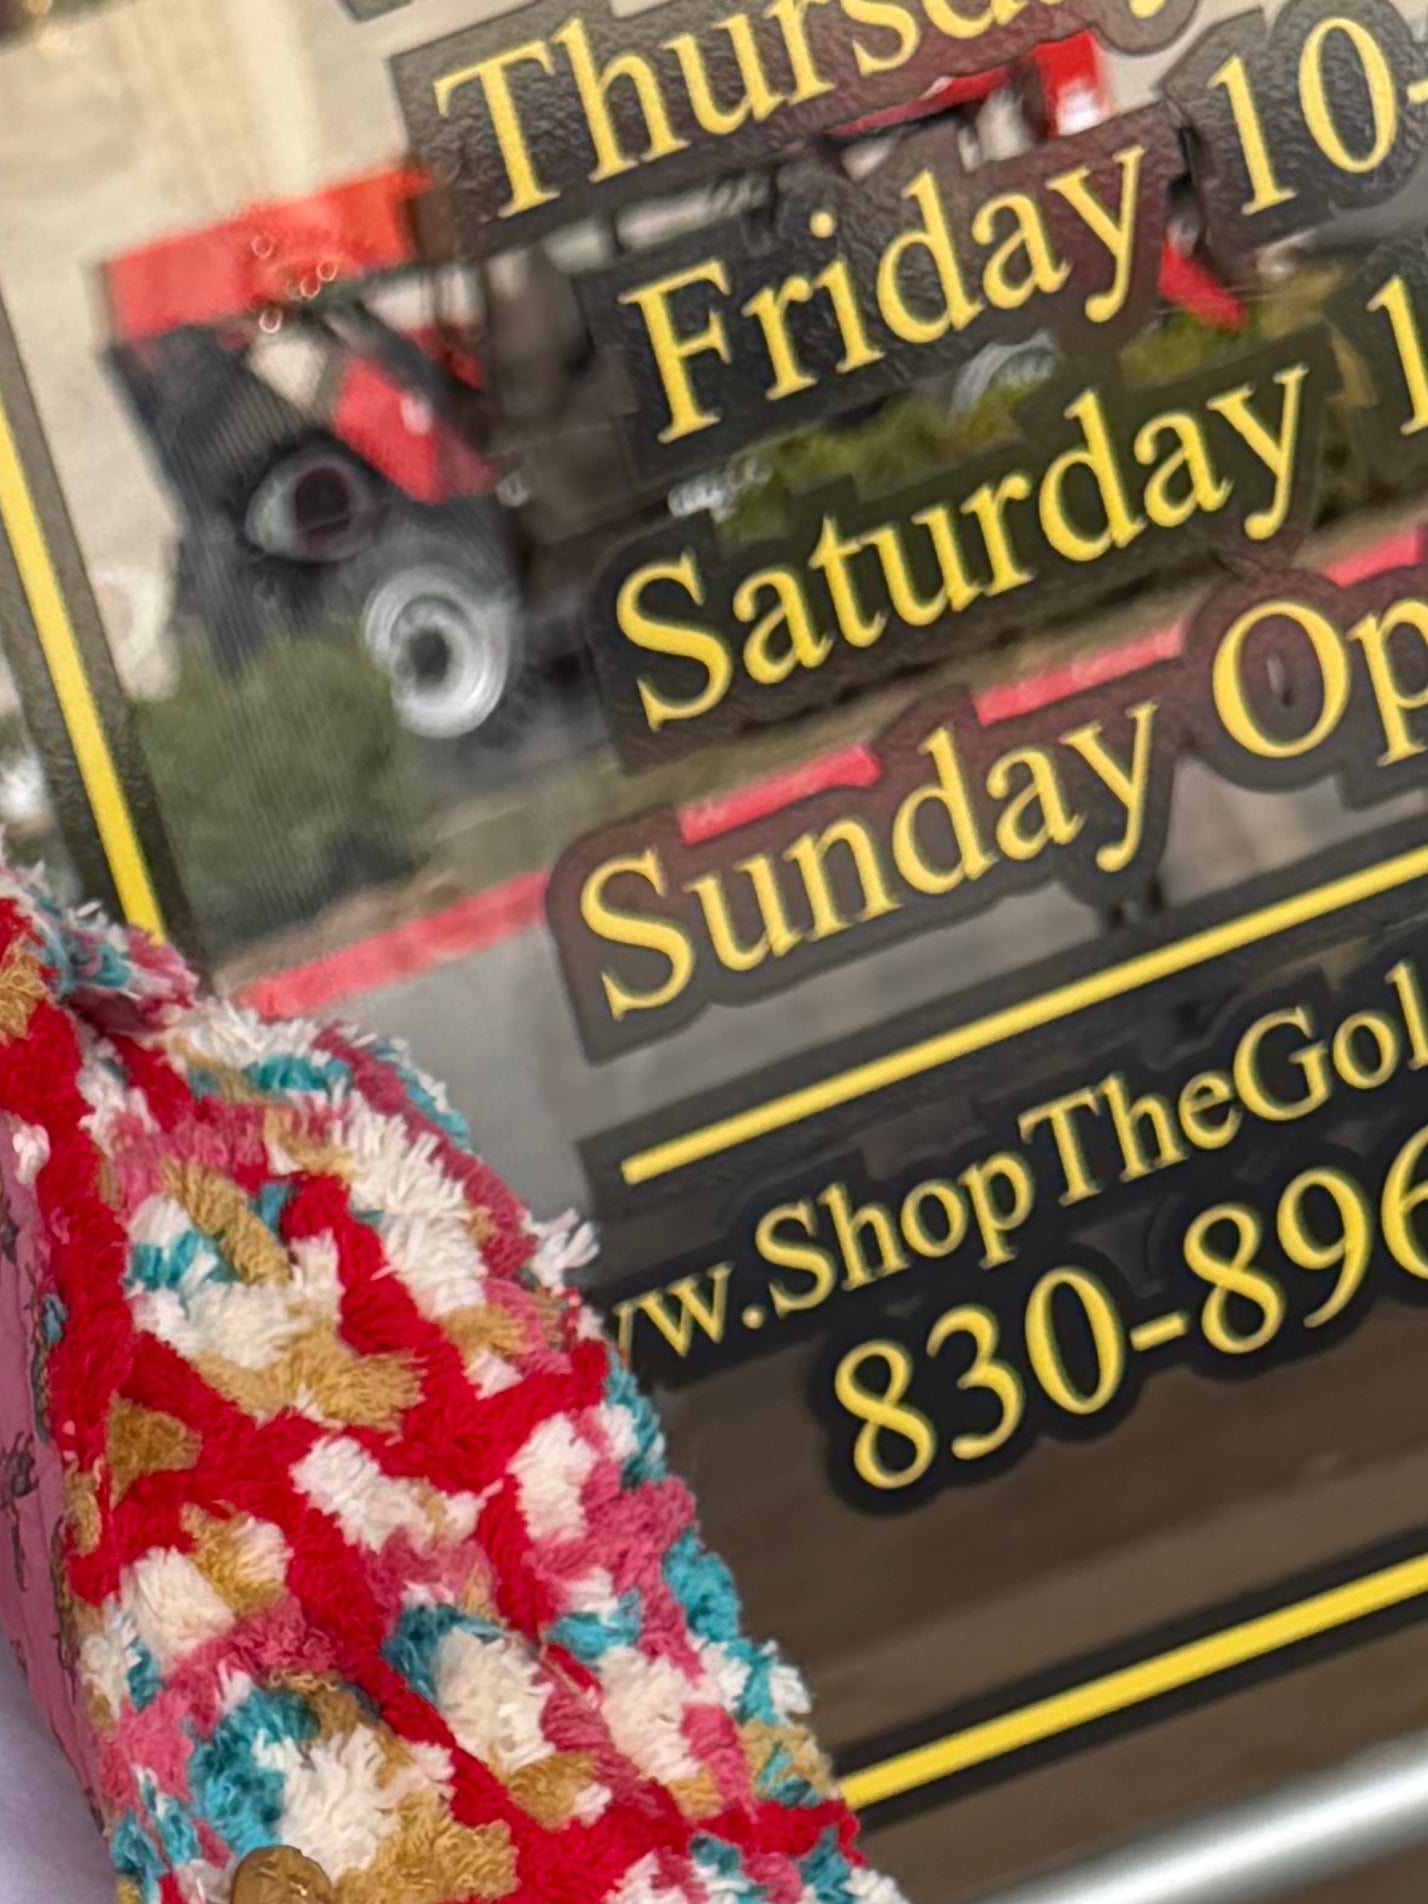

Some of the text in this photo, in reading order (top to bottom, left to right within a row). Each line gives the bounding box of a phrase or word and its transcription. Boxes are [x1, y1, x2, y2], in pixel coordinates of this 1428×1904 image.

[432, 0, 1166, 213] Thurs
[627, 147, 1142, 440] Friday
[616, 366, 1306, 728] Saturday
[580, 601, 1428, 1017] Sunday Op
